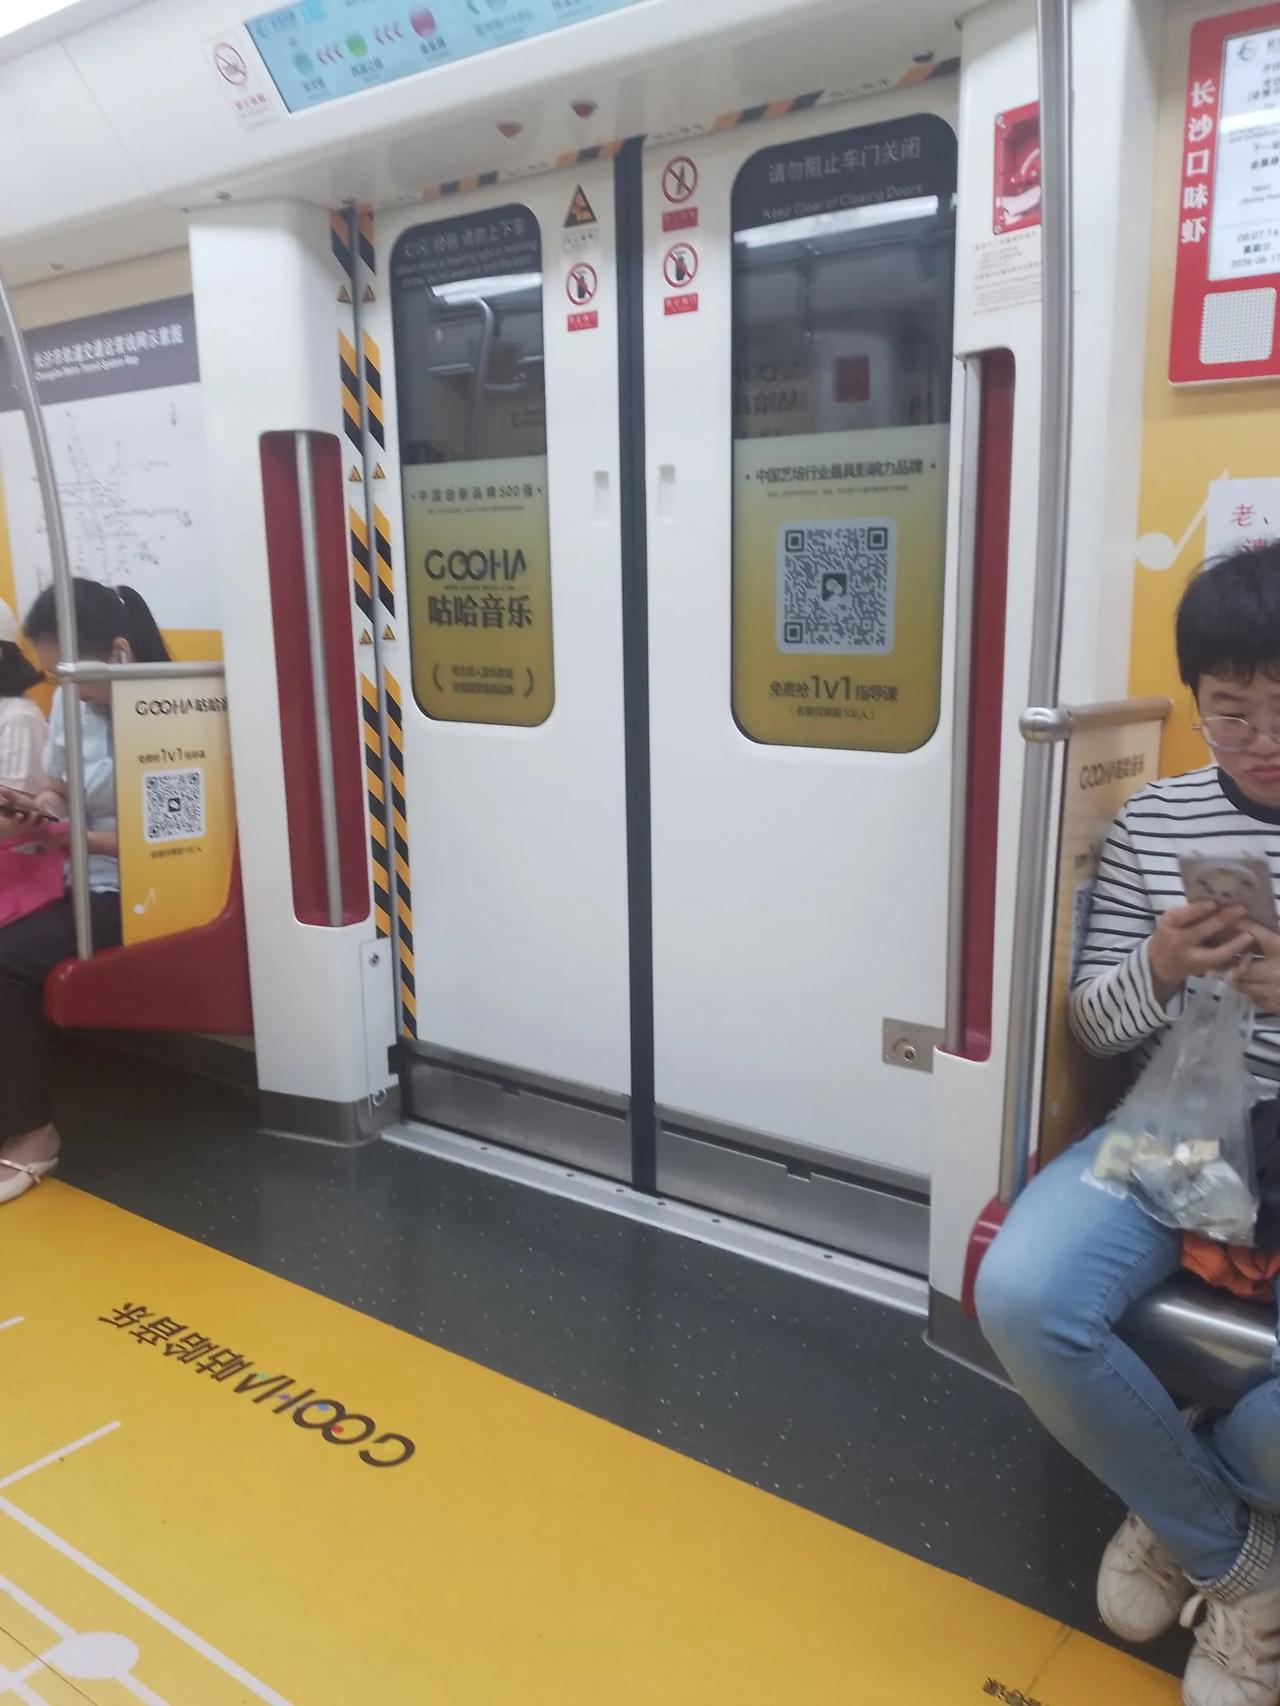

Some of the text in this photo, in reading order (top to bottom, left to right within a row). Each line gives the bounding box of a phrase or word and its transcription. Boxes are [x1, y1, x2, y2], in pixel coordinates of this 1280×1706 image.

[768, 136, 921, 184] 请勿阻止车门关闭
[1181, 79, 1216, 243] 长沙口味虾
[425, 548, 527, 580] GOOHA
[428, 594, 533, 628] 咕哈音乐
[135, 699, 193, 715] GOOHA
[98, 1302, 416, 1468] GOOHA 咕哈音乐
